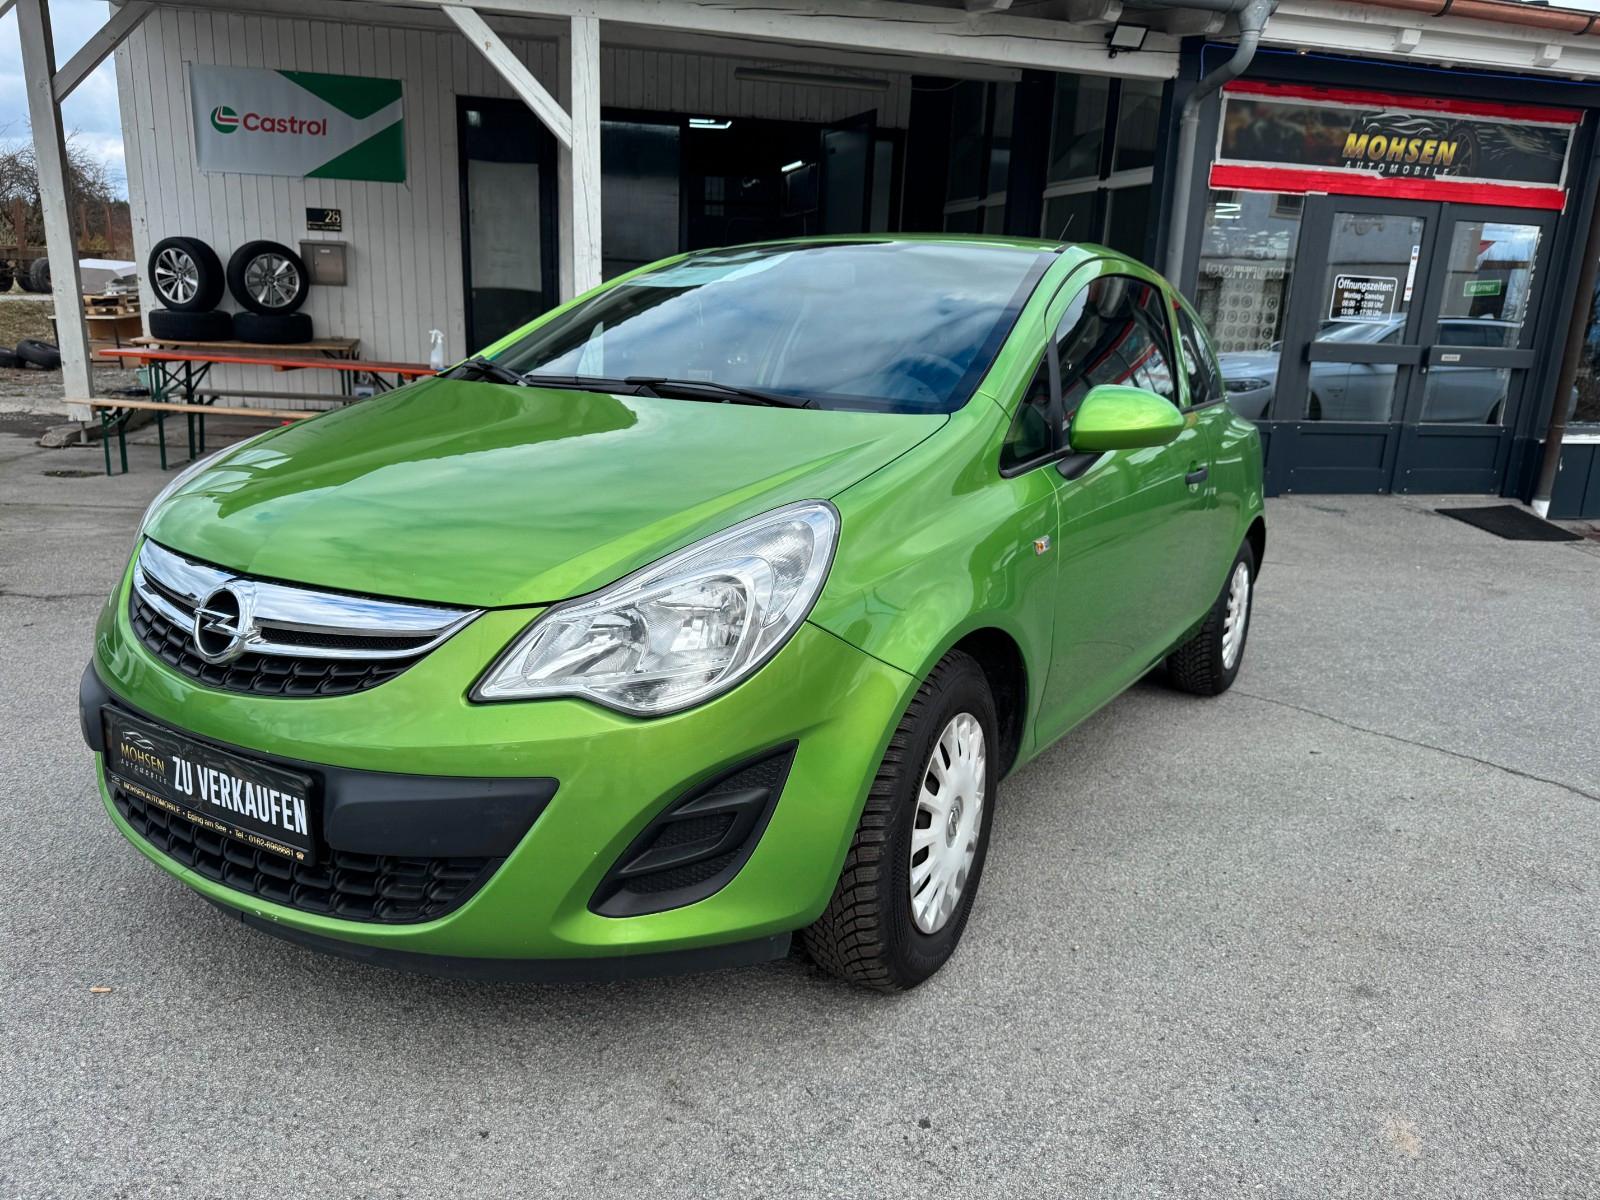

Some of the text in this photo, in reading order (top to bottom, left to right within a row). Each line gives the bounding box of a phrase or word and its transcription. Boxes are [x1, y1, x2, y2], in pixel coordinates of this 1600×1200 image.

[243, 112, 327, 136] Castrol
[1342, 133, 1457, 166] MOHSEN
[1344, 161, 1450, 177] AUTOMOBILE
[324, 211, 340, 223] 28
[1338, 278, 1394, 292] Öffnungszeiten:
[120, 742, 165, 774] MOHSEN
[120, 759, 167, 785] AUTOMOBILE
[145, 792, 180, 813] AUTOMOBILE
[172, 755, 308, 836] ZU VERKAUFEN
